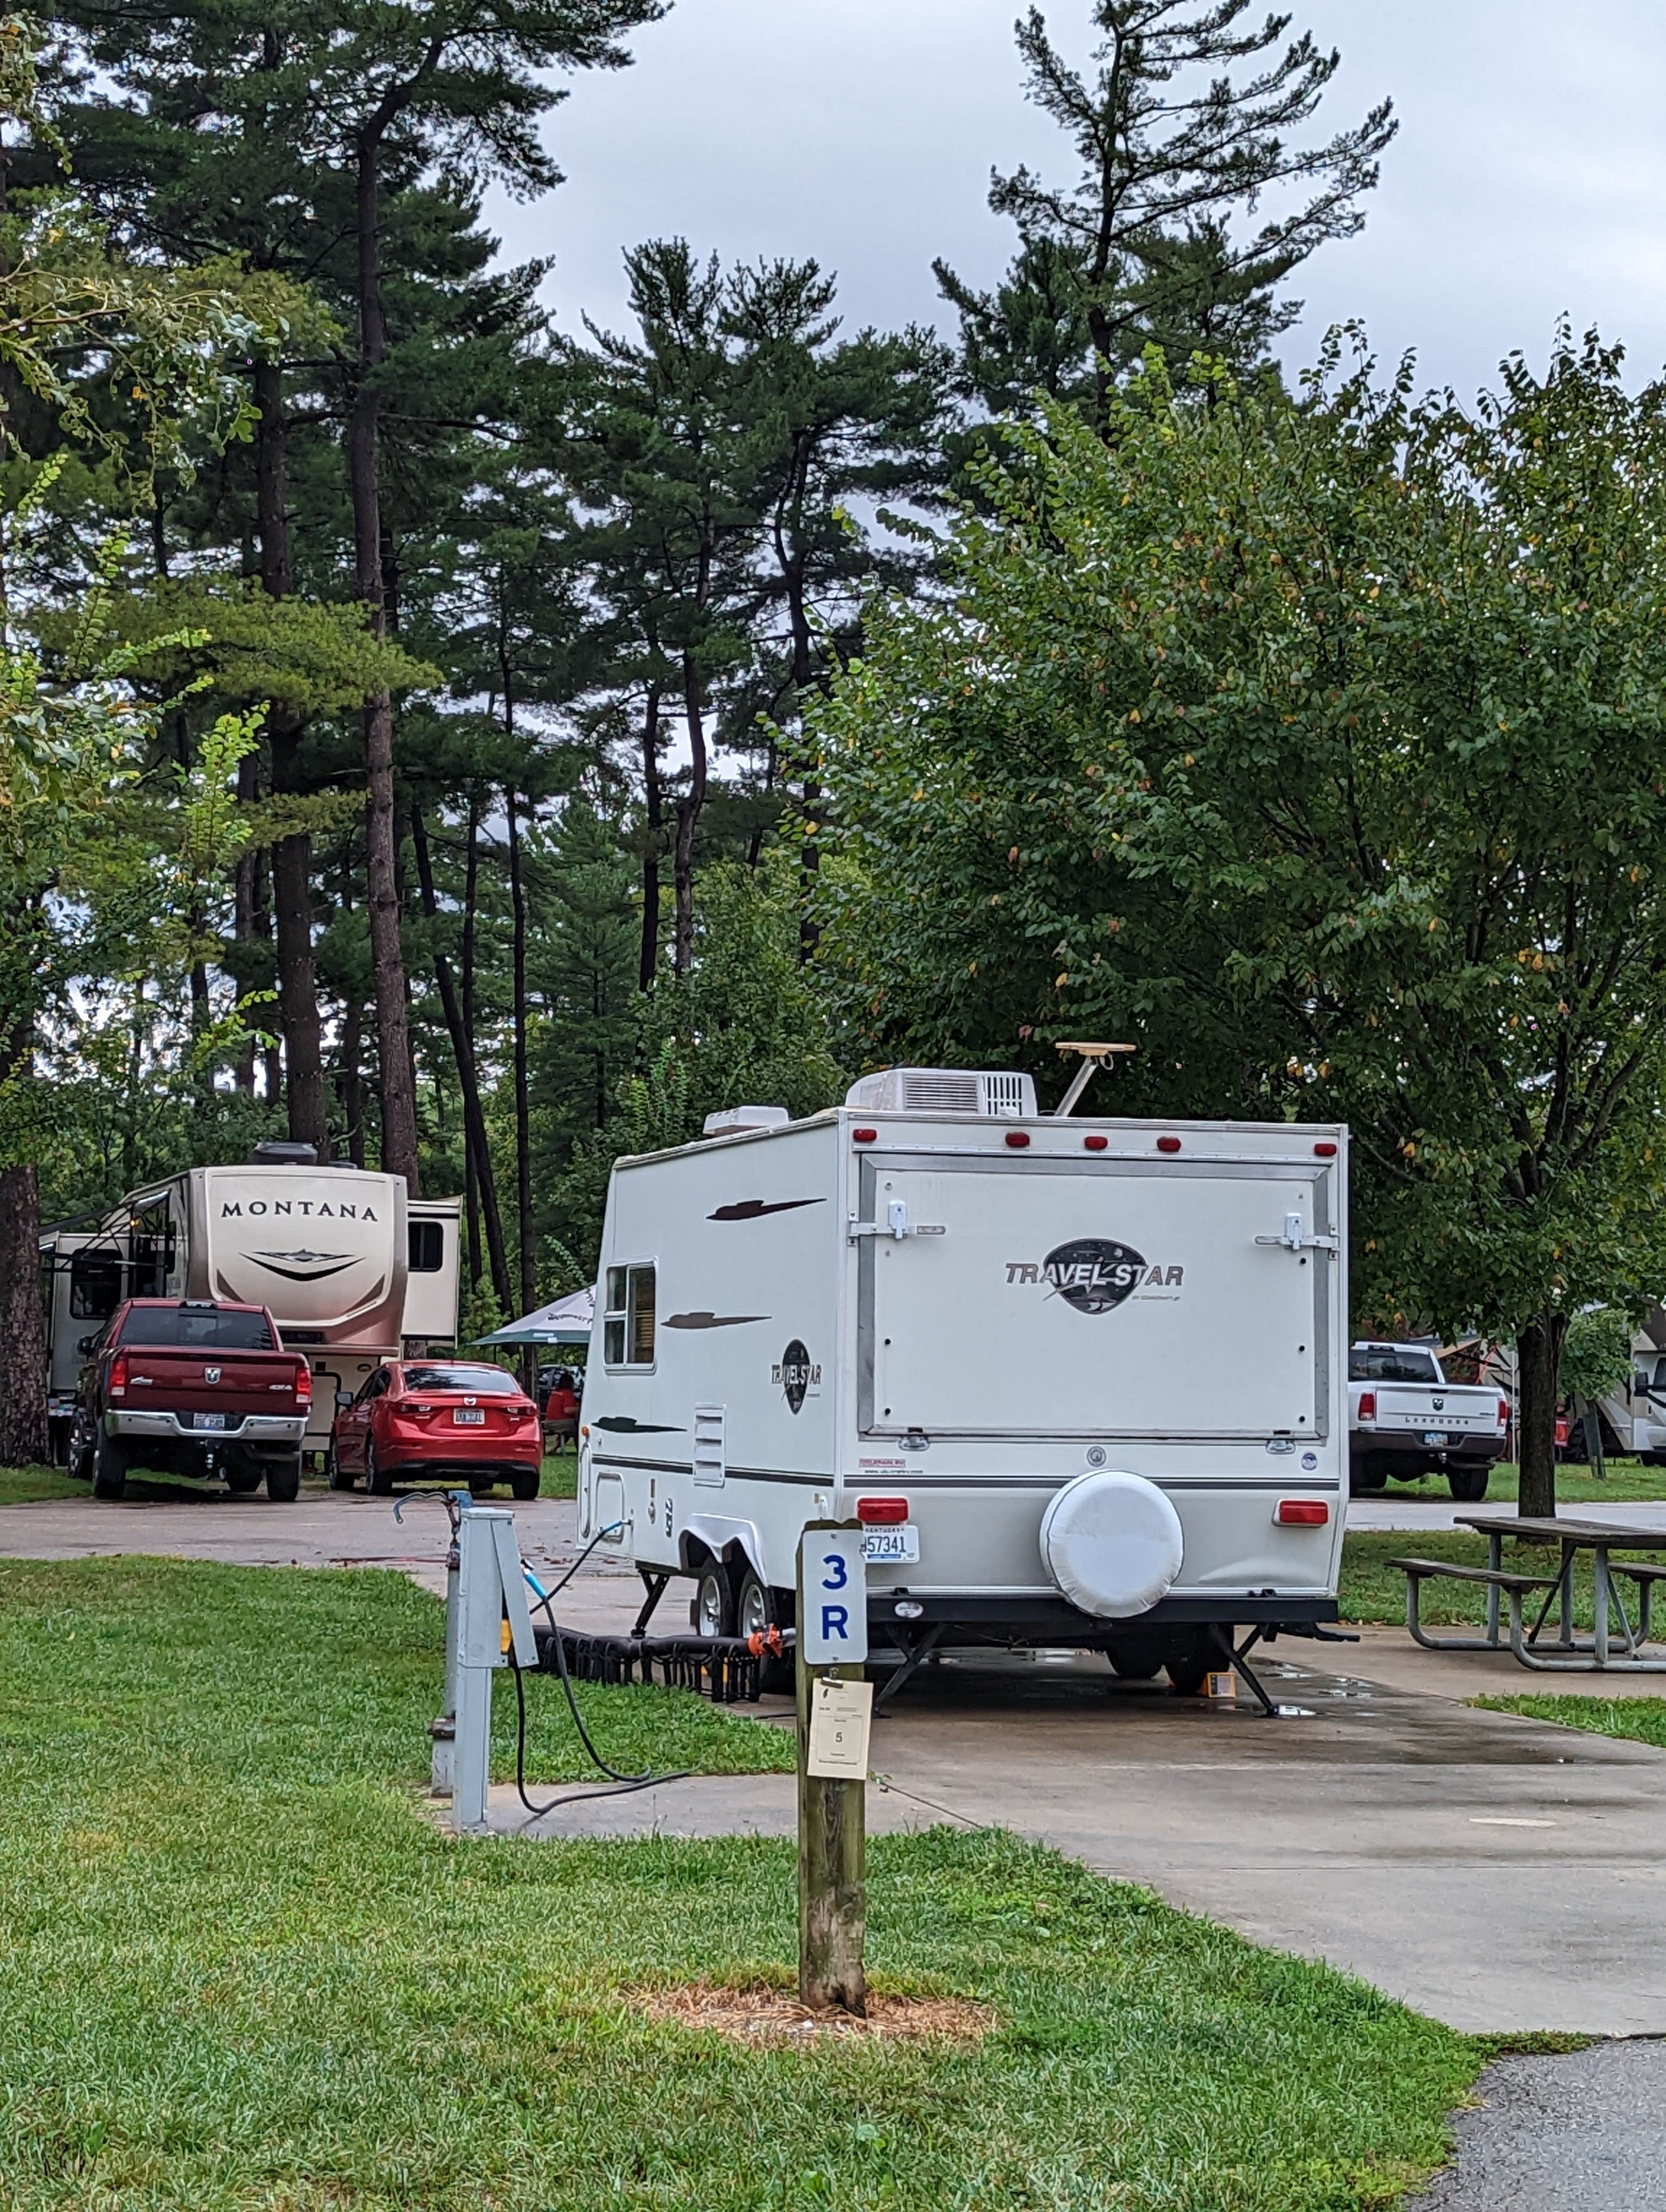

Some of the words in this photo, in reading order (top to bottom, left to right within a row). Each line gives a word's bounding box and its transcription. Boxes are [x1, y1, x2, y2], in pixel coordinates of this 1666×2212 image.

[221, 1201, 378, 1222] MONTANA
[1005, 1263, 1107, 1285] TRAVEL
[1114, 1263, 1183, 1287] STAR
[822, 1554, 848, 1590] 3
[822, 1605, 849, 1640] R
